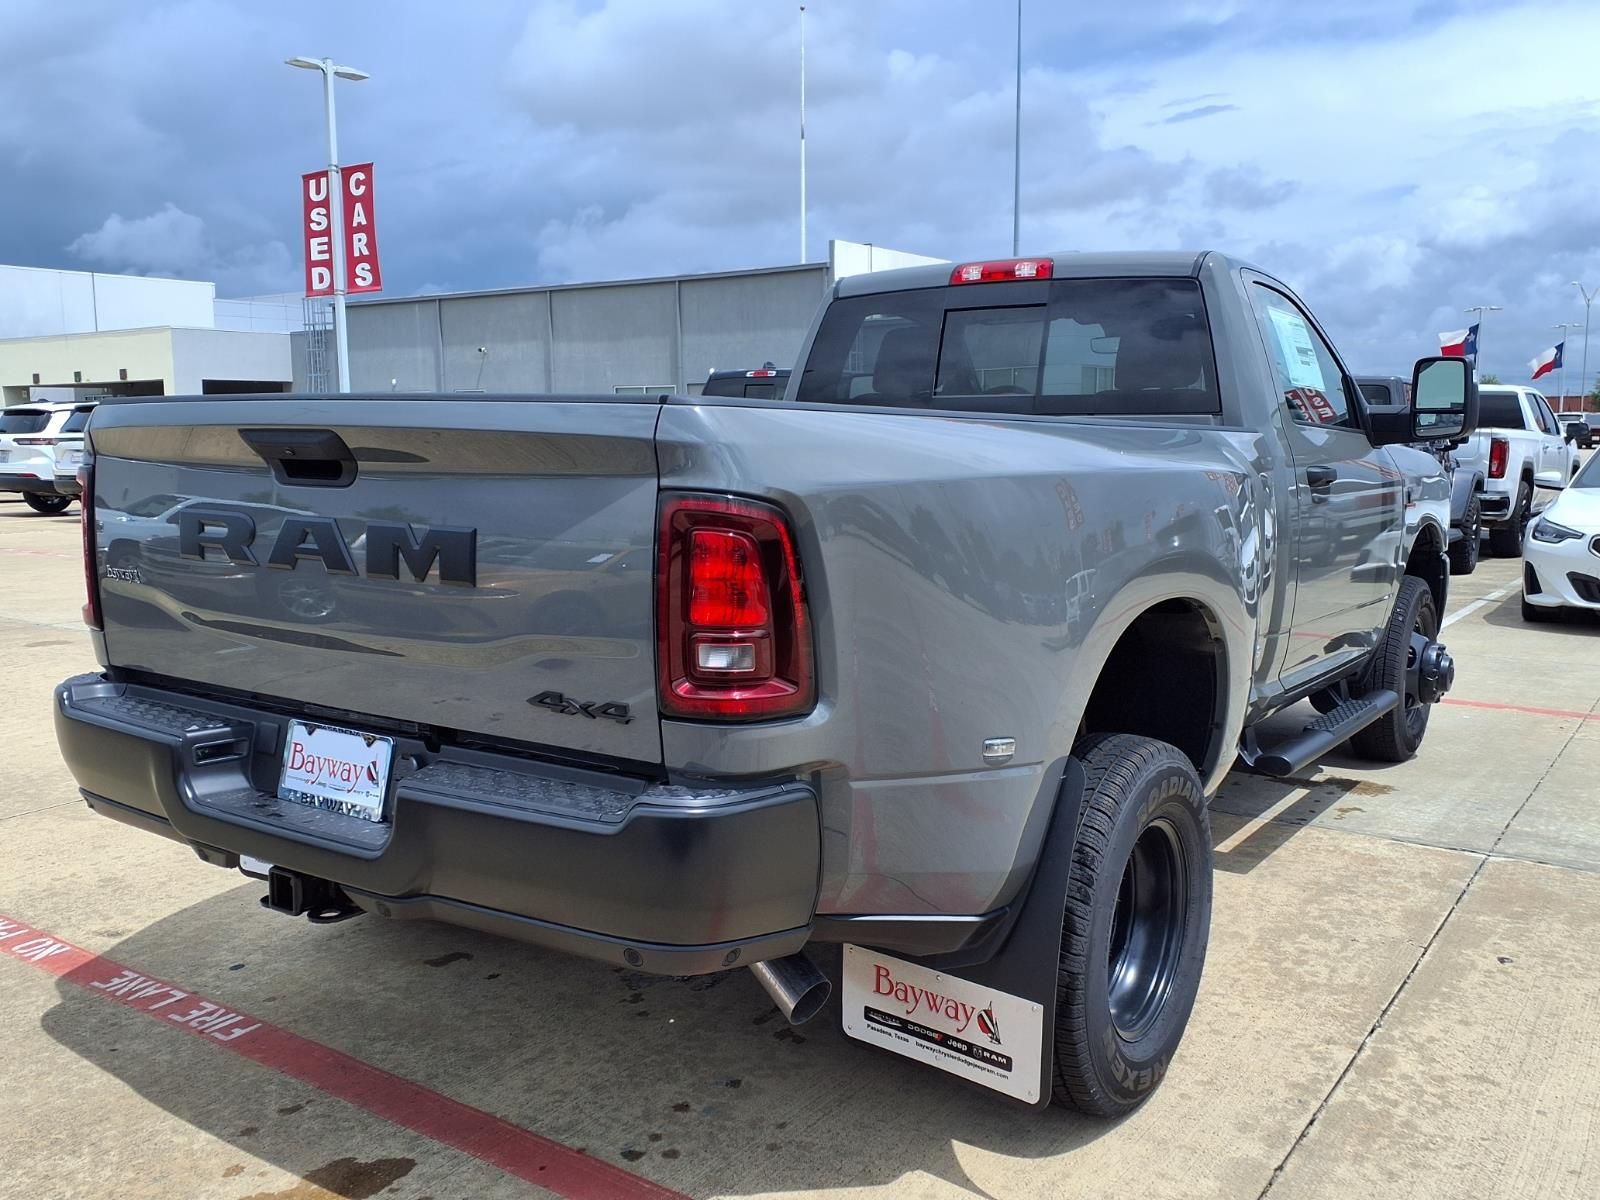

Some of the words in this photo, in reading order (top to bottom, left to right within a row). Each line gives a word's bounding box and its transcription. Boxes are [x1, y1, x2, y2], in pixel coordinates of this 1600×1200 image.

[309, 177, 330, 290] USED
[349, 172, 373, 287] CARS
[178, 507, 477, 587] RAM
[289, 741, 364, 793] Bayway
[301, 792, 354, 816] BAYWAY
[11, 937, 72, 963] NO
[90, 970, 189, 1010] LANE
[873, 964, 976, 1033] Bayway
[168, 1002, 263, 1041] FIRE
[894, 1034, 910, 1044] Texas
[907, 1024, 938, 1040] DODGE
[947, 1039, 968, 1052] Jeep
[983, 1051, 1007, 1065] RAM
